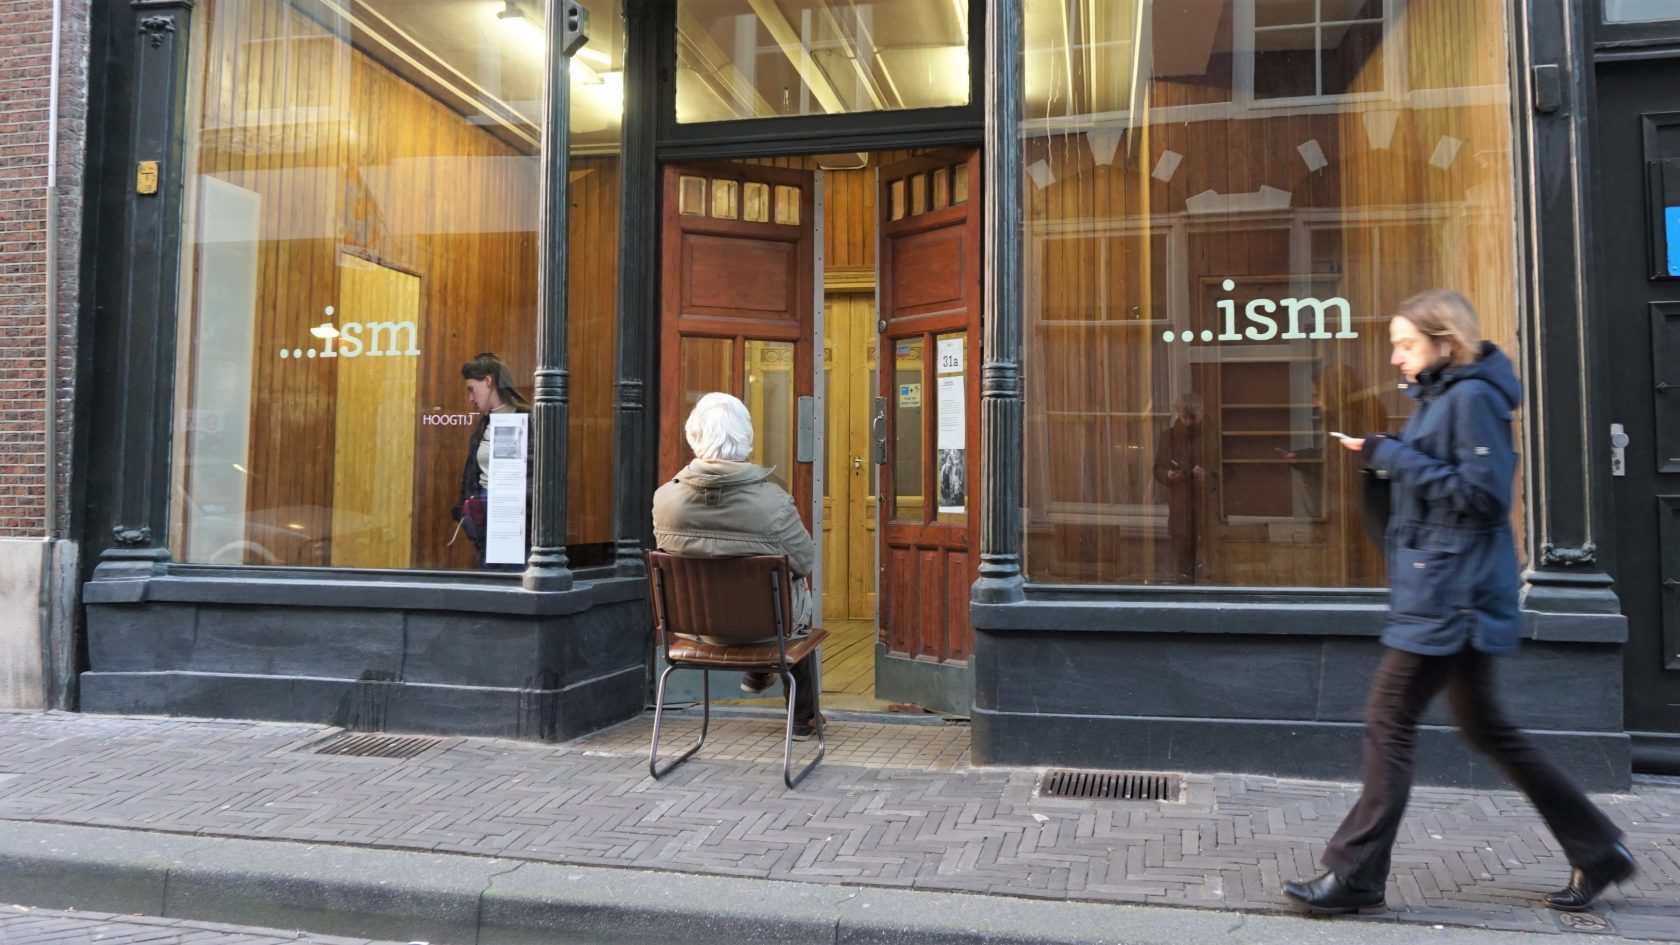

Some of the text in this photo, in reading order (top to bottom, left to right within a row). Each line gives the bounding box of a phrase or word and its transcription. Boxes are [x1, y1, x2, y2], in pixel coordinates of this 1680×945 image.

[1162, 279, 1359, 342] ...ism
[279, 305, 421, 359] ...ism
[943, 355, 959, 368] 31a
[423, 414, 473, 426] HOOGTIJ
